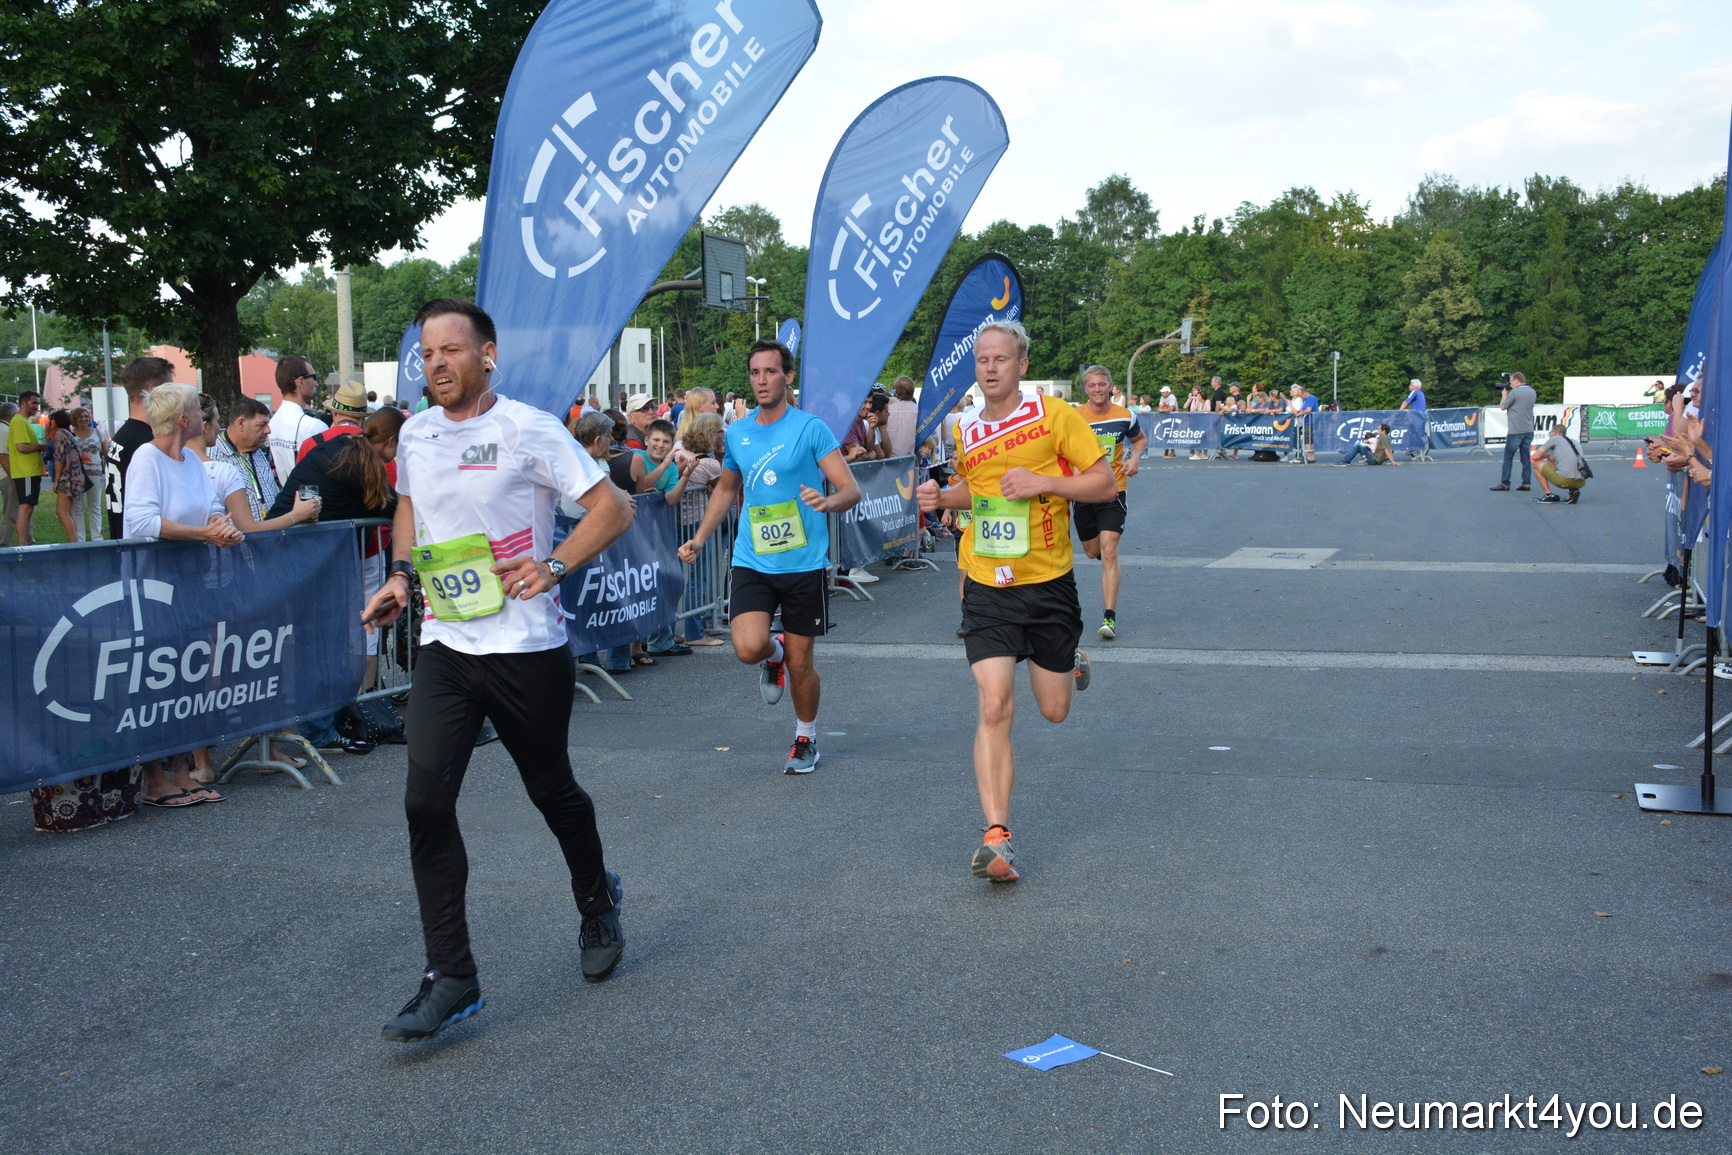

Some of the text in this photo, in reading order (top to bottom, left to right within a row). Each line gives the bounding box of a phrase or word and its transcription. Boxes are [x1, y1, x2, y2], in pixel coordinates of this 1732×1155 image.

[564, 0, 746, 238] Fischer
[626, 36, 765, 235] AUTOMOBILE
[854, 114, 966, 291] Fischer
[892, 145, 974, 288] AUTOMOBILE
[1163, 427, 1205, 438] Fischer
[1224, 424, 1274, 435] Frischmann
[1430, 421, 1466, 432] Frischmann
[1592, 411, 1617, 426] AOK
[1643, 420, 1665, 428] BESTEN
[965, 425, 1051, 472] MAX BÖGL
[761, 521, 793, 541] 802
[981, 520, 1016, 541] 849
[431, 568, 481, 600] 999
[577, 558, 660, 607] Fischer
[586, 596, 657, 629] AUTOMOBILE
[94, 621, 294, 701] Fischer
[115, 675, 280, 734] AUTOMOBILE
